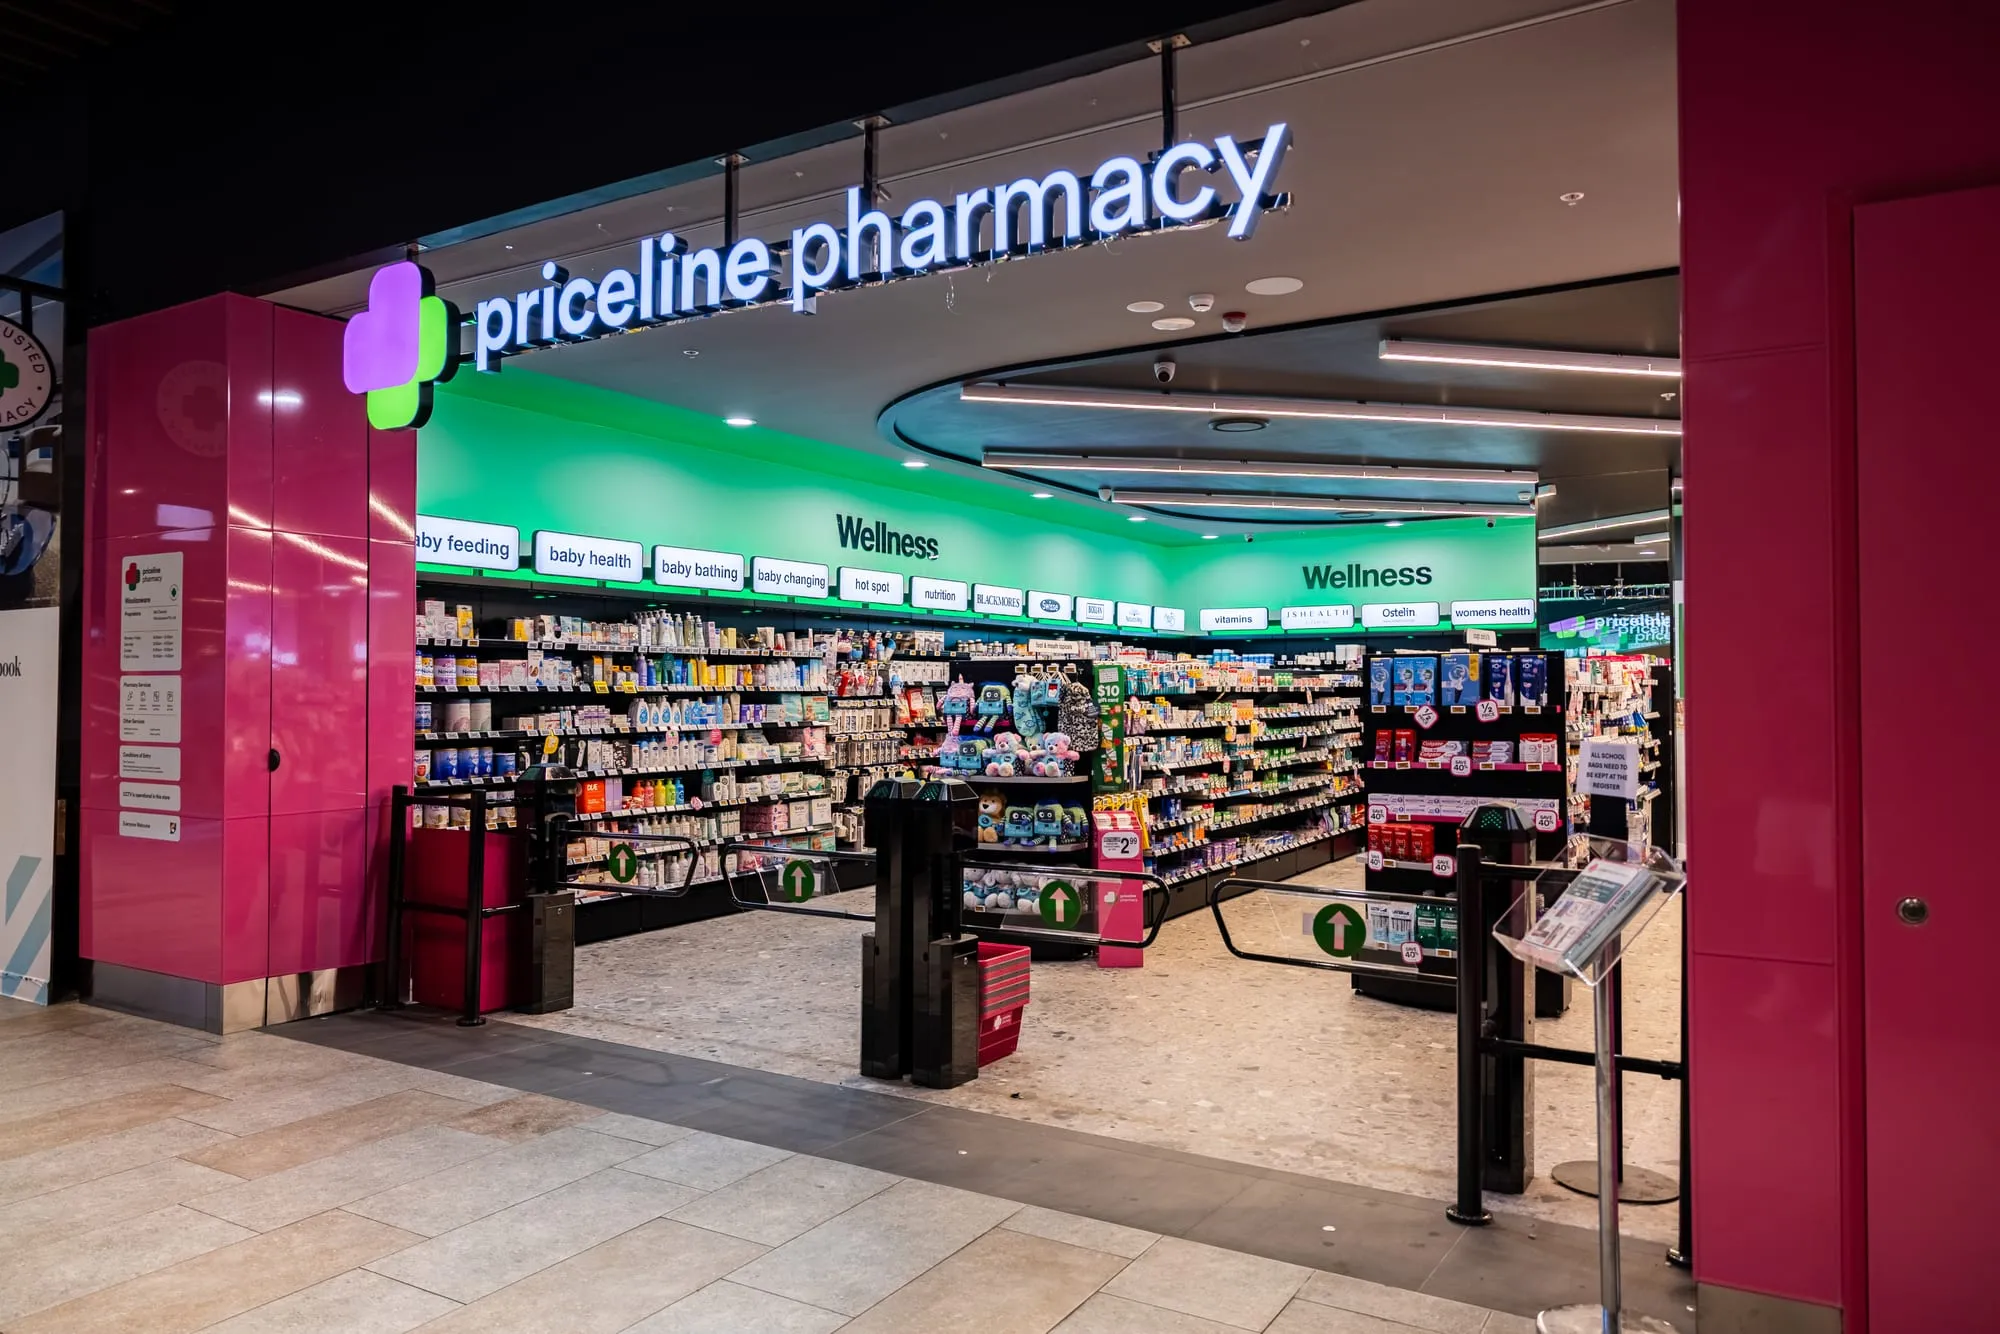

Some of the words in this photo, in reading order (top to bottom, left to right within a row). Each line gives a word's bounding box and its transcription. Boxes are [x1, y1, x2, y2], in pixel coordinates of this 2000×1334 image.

[476, 232, 771, 372] priceline
[792, 122, 1289, 313] pharmacy
[3, 326, 45, 373] USTED
[0, 398, 36, 422] ACY
[416, 532, 442, 552] aby
[447, 535, 510, 559] feeding
[836, 513, 939, 560] Wellness
[549, 546, 585, 567] baby
[590, 551, 631, 569] health
[661, 560, 691, 577] baby
[695, 563, 738, 582] bathing
[758, 569, 781, 583] baby
[784, 571, 826, 589] changing
[1302, 564, 1432, 589] Wellness
[855, 579, 869, 591] hot
[872, 581, 890, 595] spot
[924, 589, 956, 601] nutrition
[976, 593, 1020, 608] BLACKMORES
[1214, 615, 1253, 624] vitamins
[1382, 608, 1415, 618] Ostelin
[1455, 609, 1497, 618] womens
[1499, 607, 1530, 617] health
[0, 655, 21, 676] ook
[1097, 685, 1120, 697] $10
